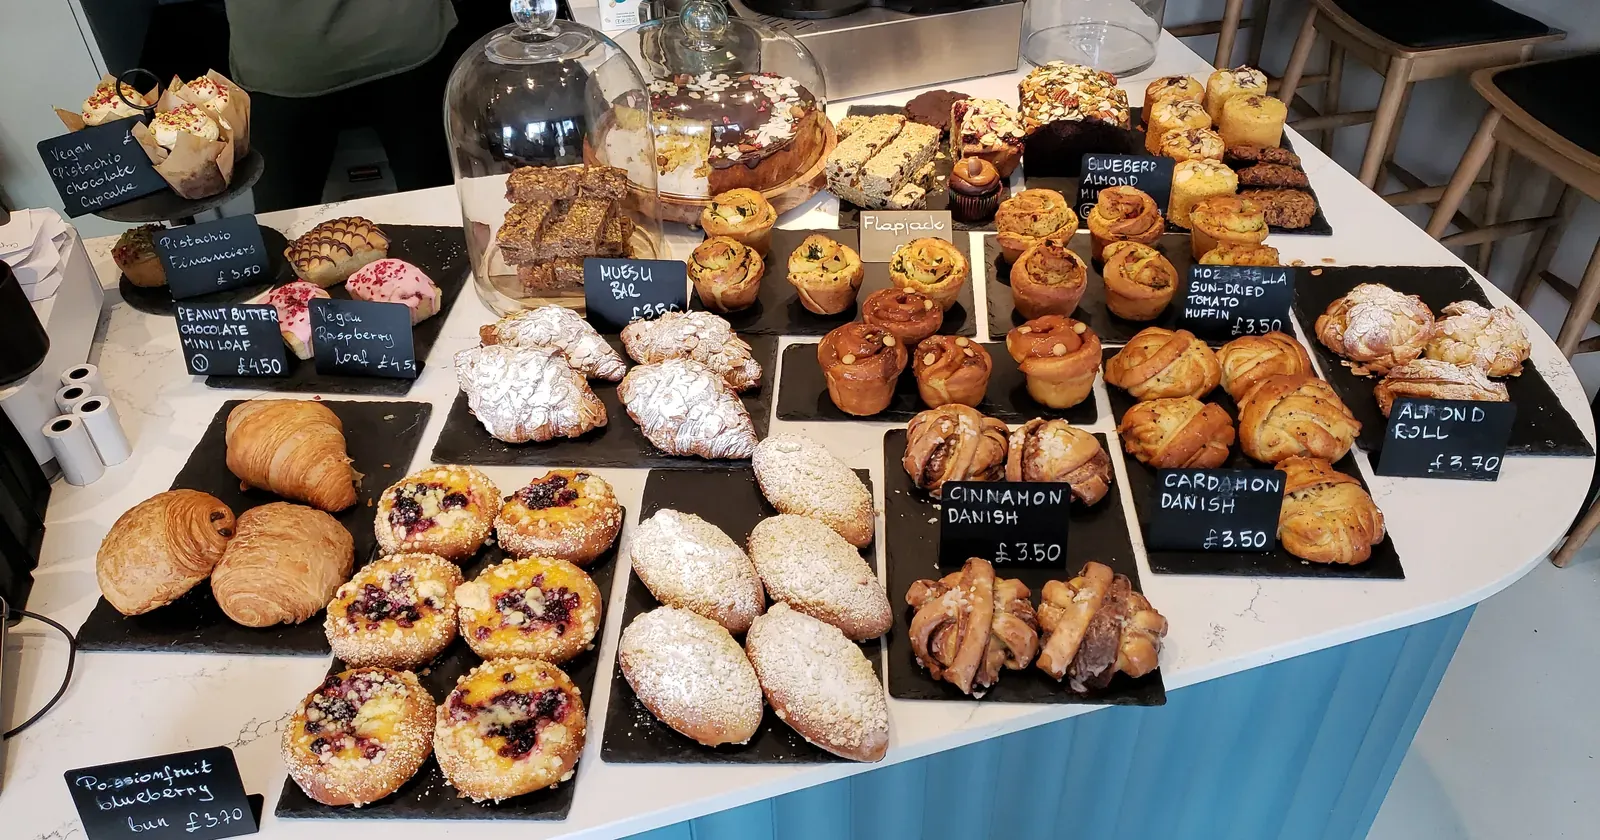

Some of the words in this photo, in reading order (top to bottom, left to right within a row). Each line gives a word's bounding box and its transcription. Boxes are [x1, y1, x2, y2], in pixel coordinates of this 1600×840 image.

[50, 142, 92, 161] Vegan
[52, 153, 121, 179] Pistachio
[1082, 172, 1139, 187] ALMOND
[863, 214, 945, 236] Flapjack
[159, 230, 231, 250] Pistachio
[169, 244, 256, 269] Financiers
[609, 280, 641, 300] BAR
[1189, 281, 1265, 298] SUN-DRIED
[1187, 294, 1240, 308] TOMATO
[177, 306, 227, 321] PEANUT
[230, 307, 279, 323] BUTTER
[317, 306, 362, 327] Vegan
[1185, 308, 1230, 321] MUFFIN
[180, 323, 249, 336] CHOCOLATE
[1231, 316, 1283, 336] £3.50
[183, 338, 215, 351] MINI
[218, 340, 252, 352] LOAF
[315, 325, 395, 349] Raspberry
[237, 357, 282, 375] £4.50
[949, 486, 1063, 506] CINNAMON
[1161, 493, 1236, 514] DANISH
[947, 508, 1019, 526] DANISH
[1203, 528, 1267, 550] £3.50
[185, 807, 243, 833] £3.70
